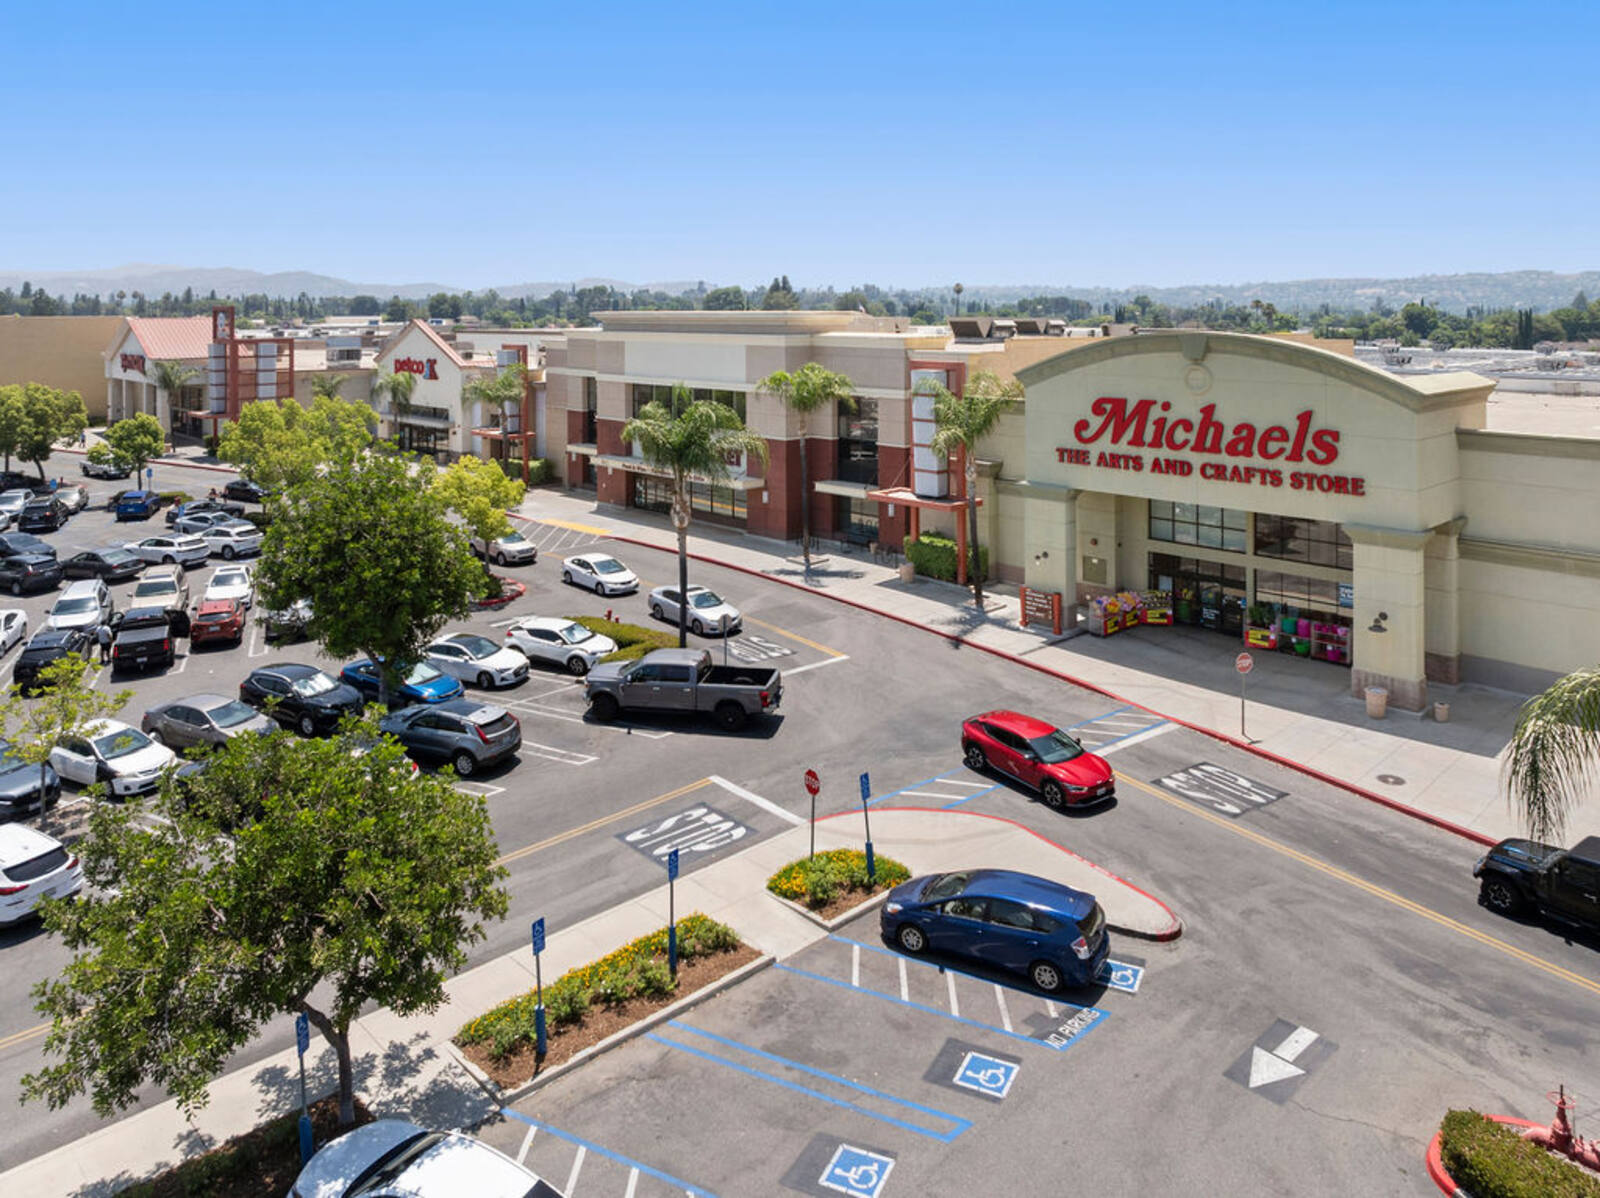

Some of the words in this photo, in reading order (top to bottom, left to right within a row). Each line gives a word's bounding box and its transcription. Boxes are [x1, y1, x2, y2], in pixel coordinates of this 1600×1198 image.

[394, 357, 424, 374] petco
[1074, 397, 1339, 466] Michaels
[1057, 447, 1089, 466] THE
[1096, 452, 1143, 474] ARTS
[1150, 457, 1192, 478] AND
[1199, 462, 1283, 489] CRAFTS
[1289, 471, 1364, 497] STORE
[804, 776, 820, 789] STOP
[1161, 764, 1277, 814] STOP
[625, 808, 747, 862] STOP
[1044, 1032, 1068, 1050] NO
[1058, 1007, 1101, 1038] PARKING
